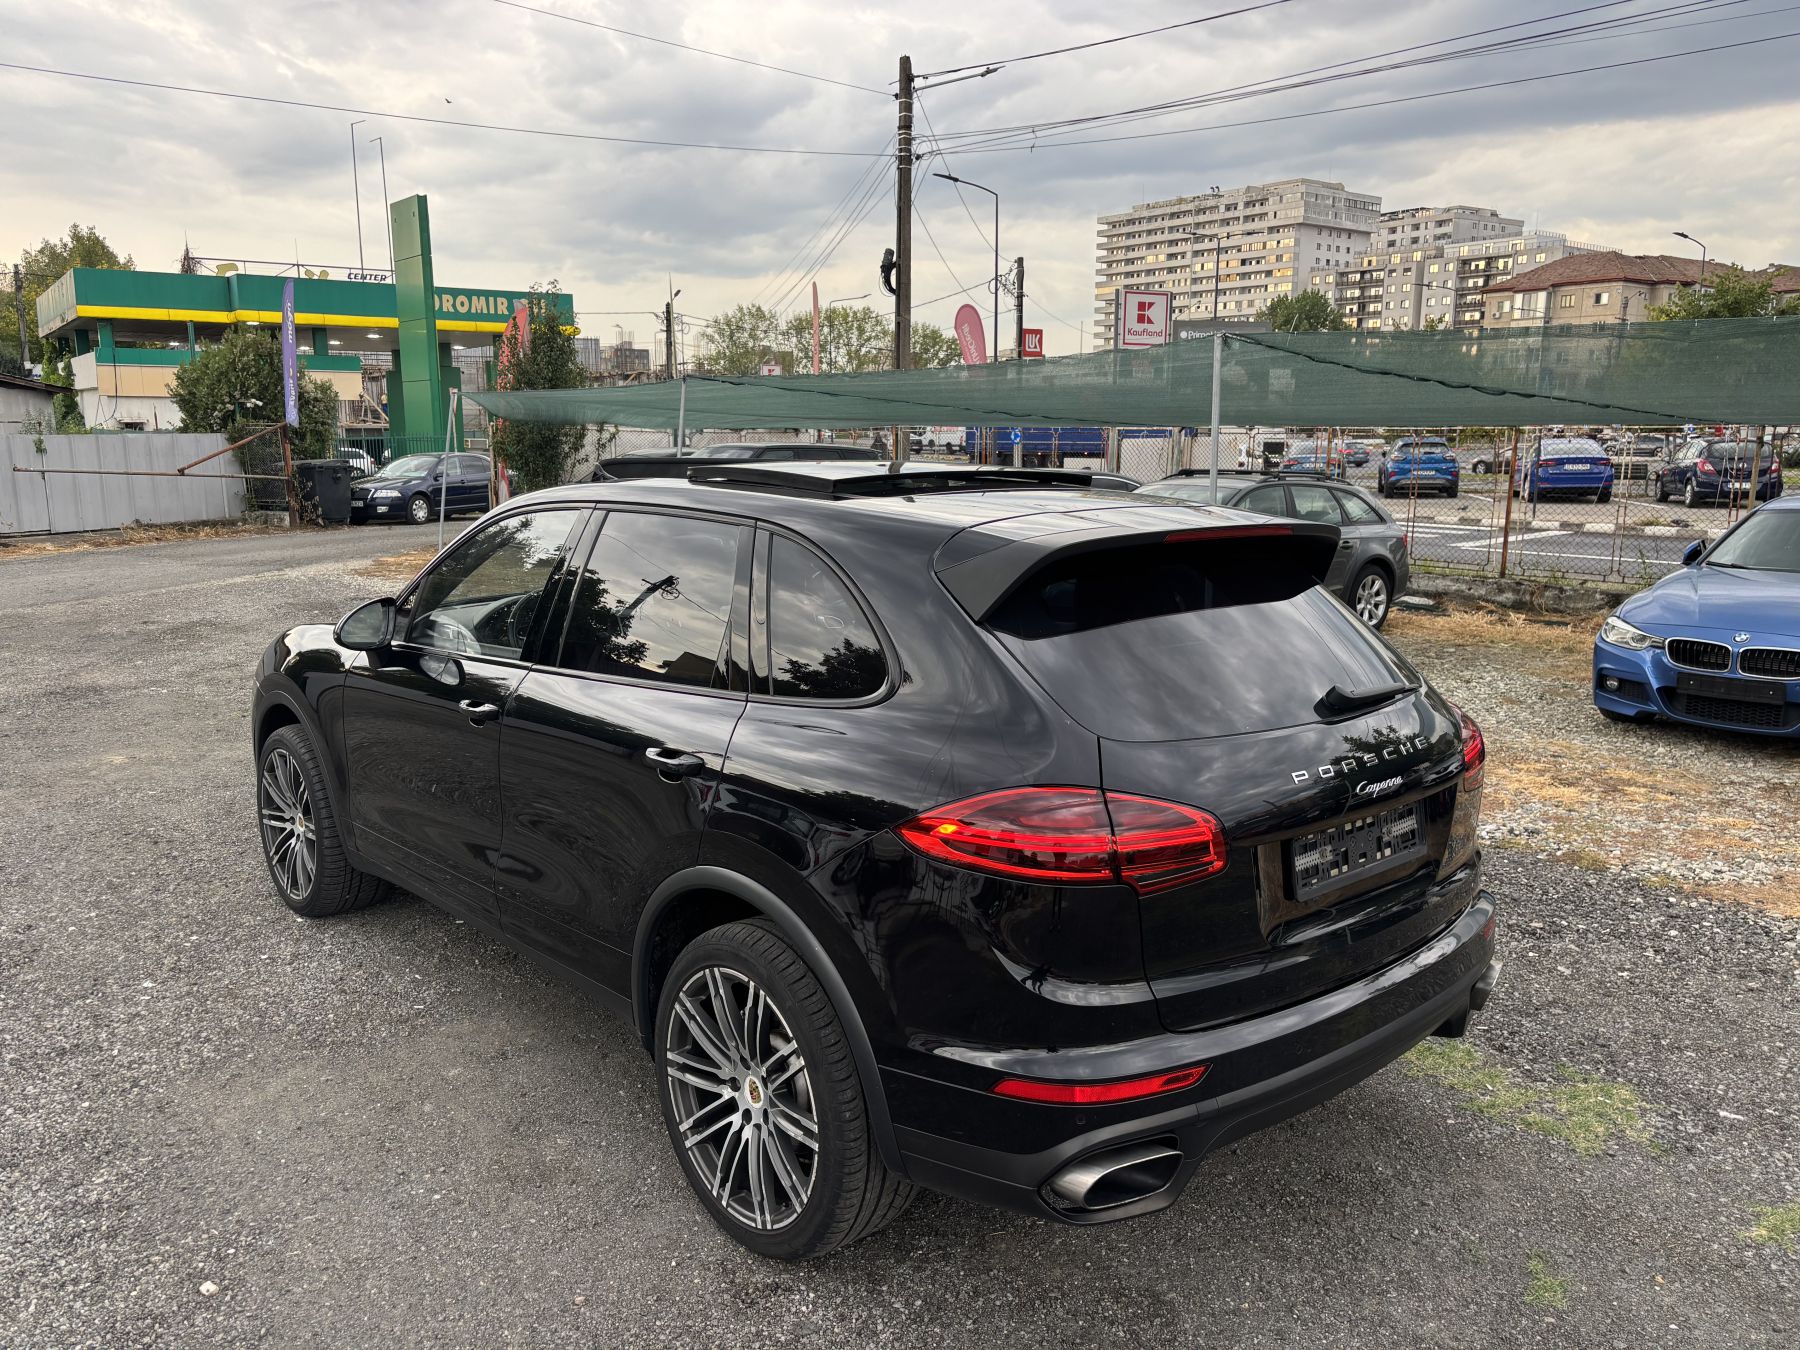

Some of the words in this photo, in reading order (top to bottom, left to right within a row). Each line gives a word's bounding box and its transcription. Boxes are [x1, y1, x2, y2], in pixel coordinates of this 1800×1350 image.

[347, 272, 387, 281] CENTER
[1127, 328, 1163, 337] Kaufland
[1291, 736, 1428, 785] PORSCHE
[1356, 775, 1404, 798] Cayenne
